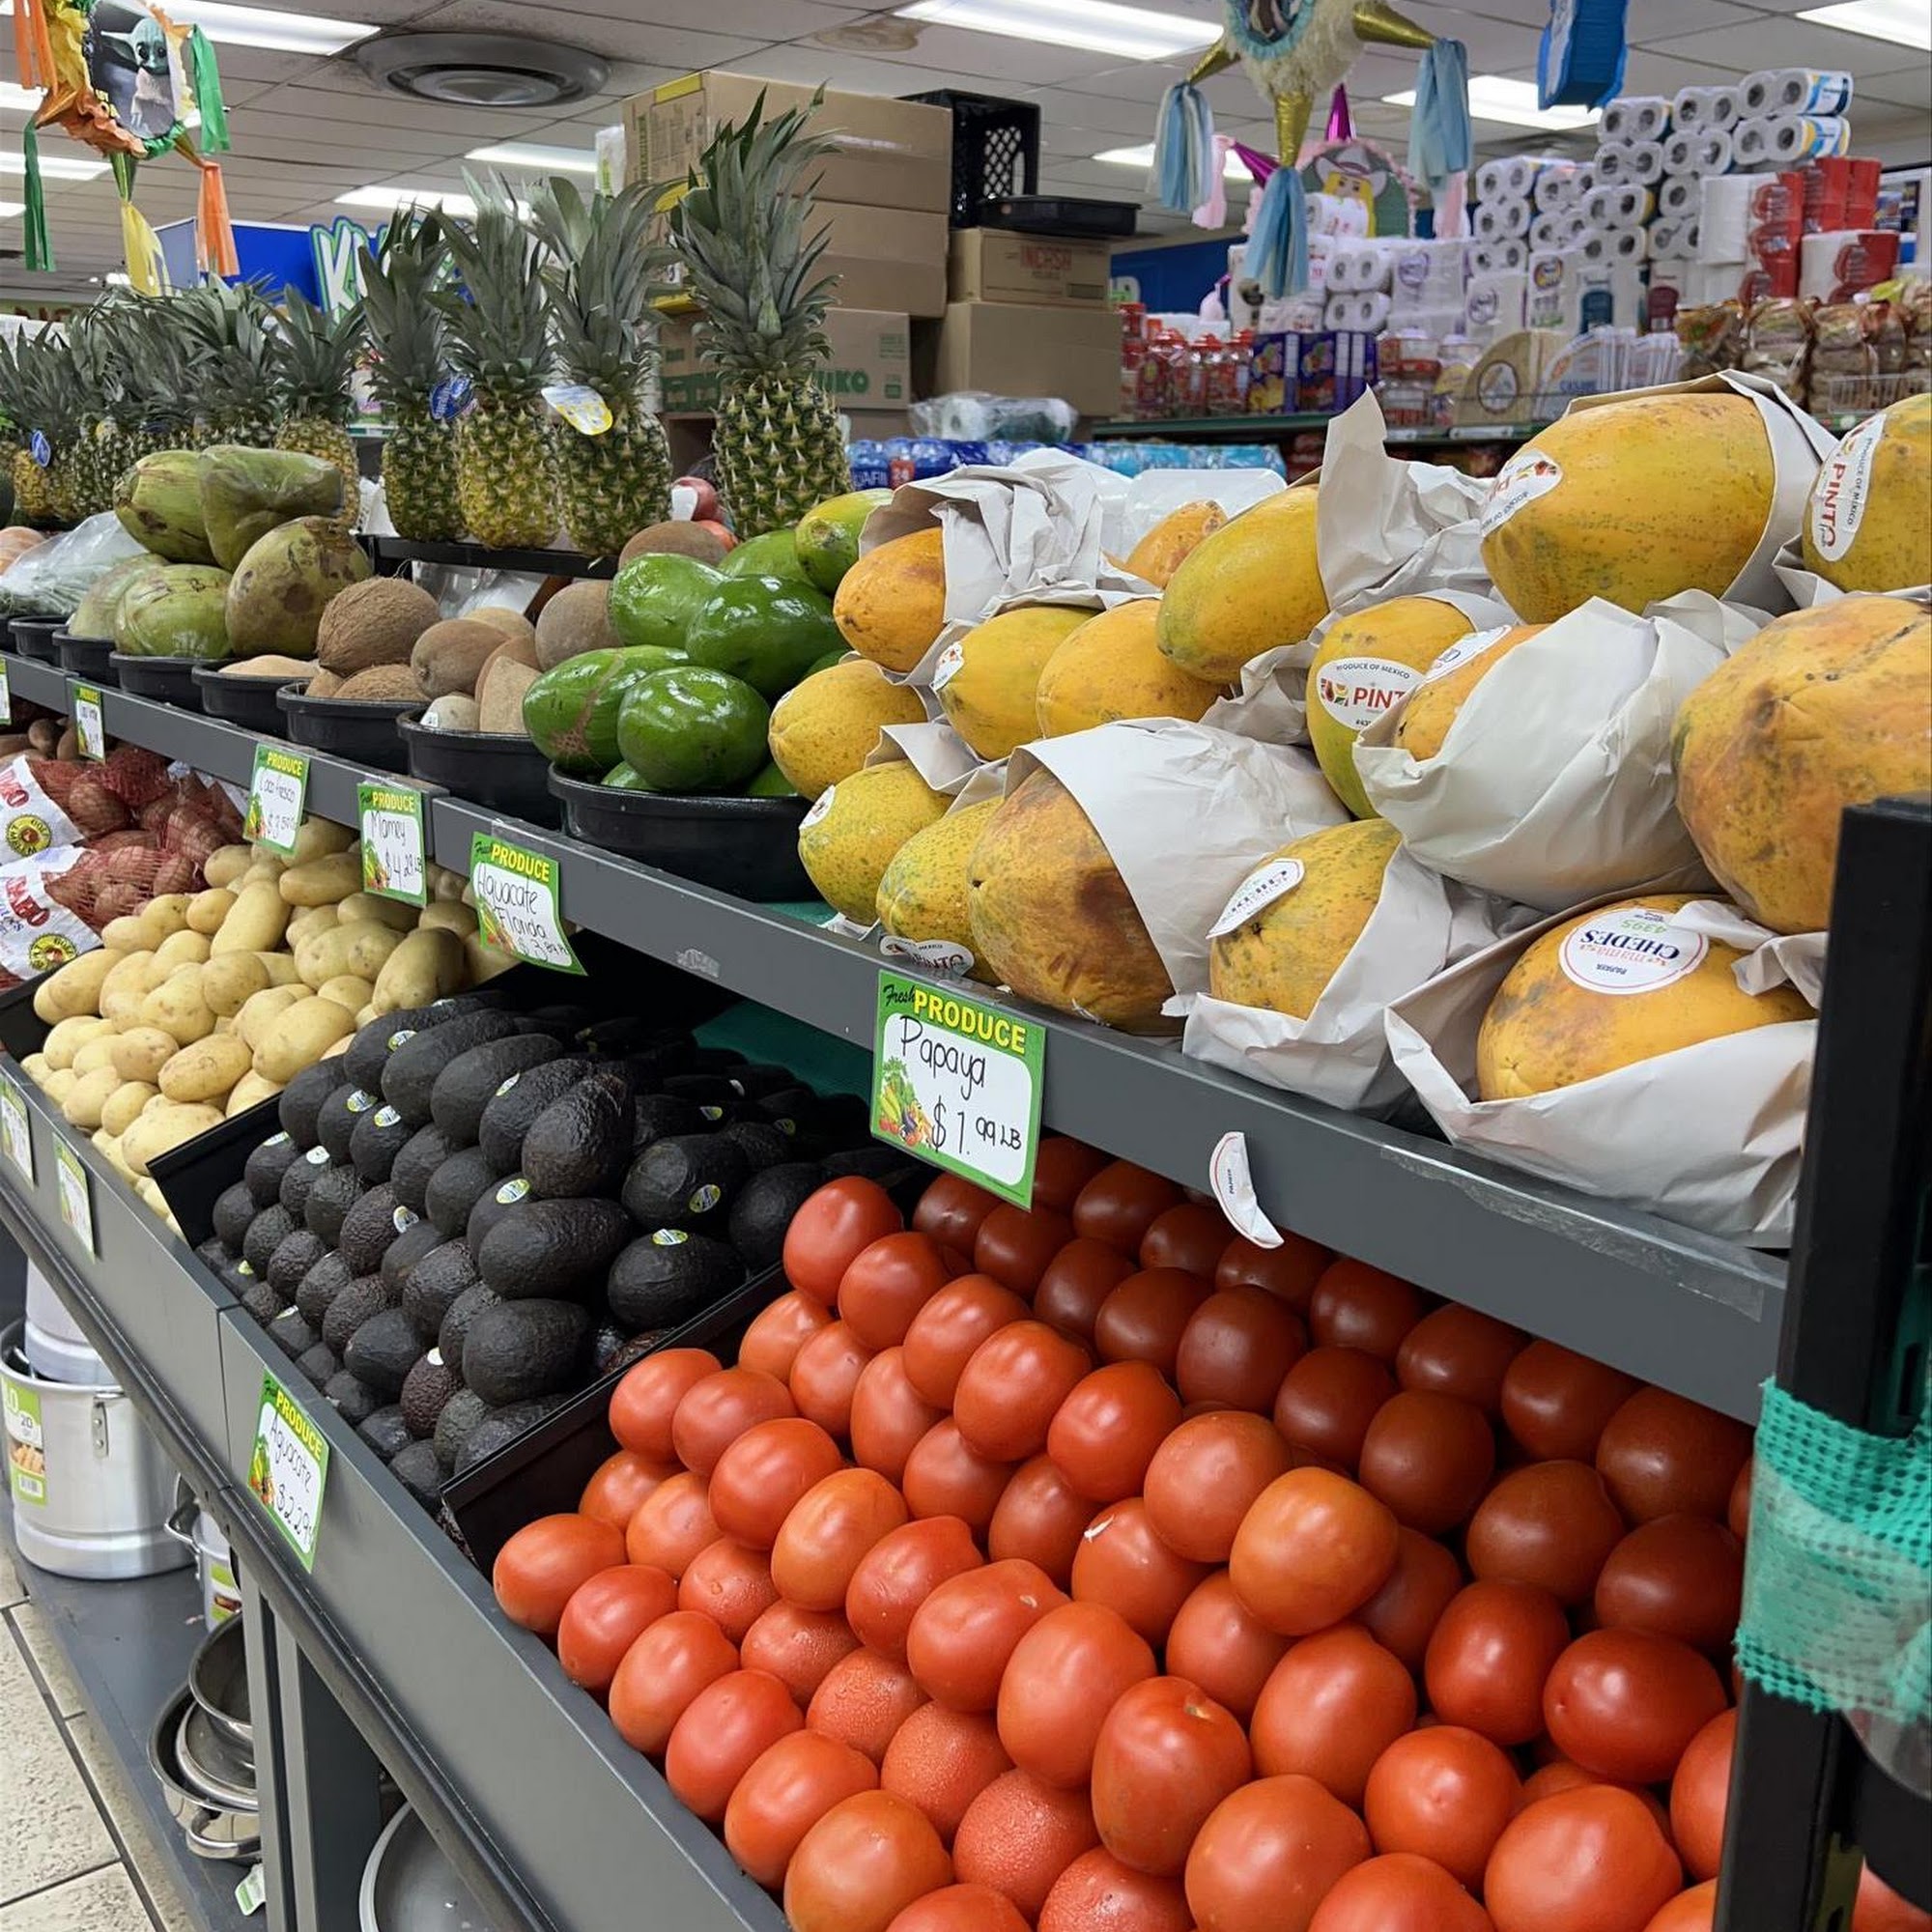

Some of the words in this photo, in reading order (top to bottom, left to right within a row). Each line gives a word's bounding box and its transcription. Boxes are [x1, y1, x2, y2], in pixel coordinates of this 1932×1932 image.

[1822, 463, 1846, 548] PINTO
[1369, 663, 1380, 671] OF
[1381, 666, 1410, 680] MEXICO
[1352, 687, 1406, 709] PINT
[268, 752, 304, 777] PRODUCE
[372, 791, 416, 813] PRODUCE
[491, 843, 551, 883] PRODUCE
[1580, 929, 1681, 960] CHEDES
[883, 983, 916, 1008] Fresh
[914, 987, 1027, 1055] PRODUCE
[899, 1015, 986, 1101] Papaya
[276, 1388, 324, 1462] PRODUCE
